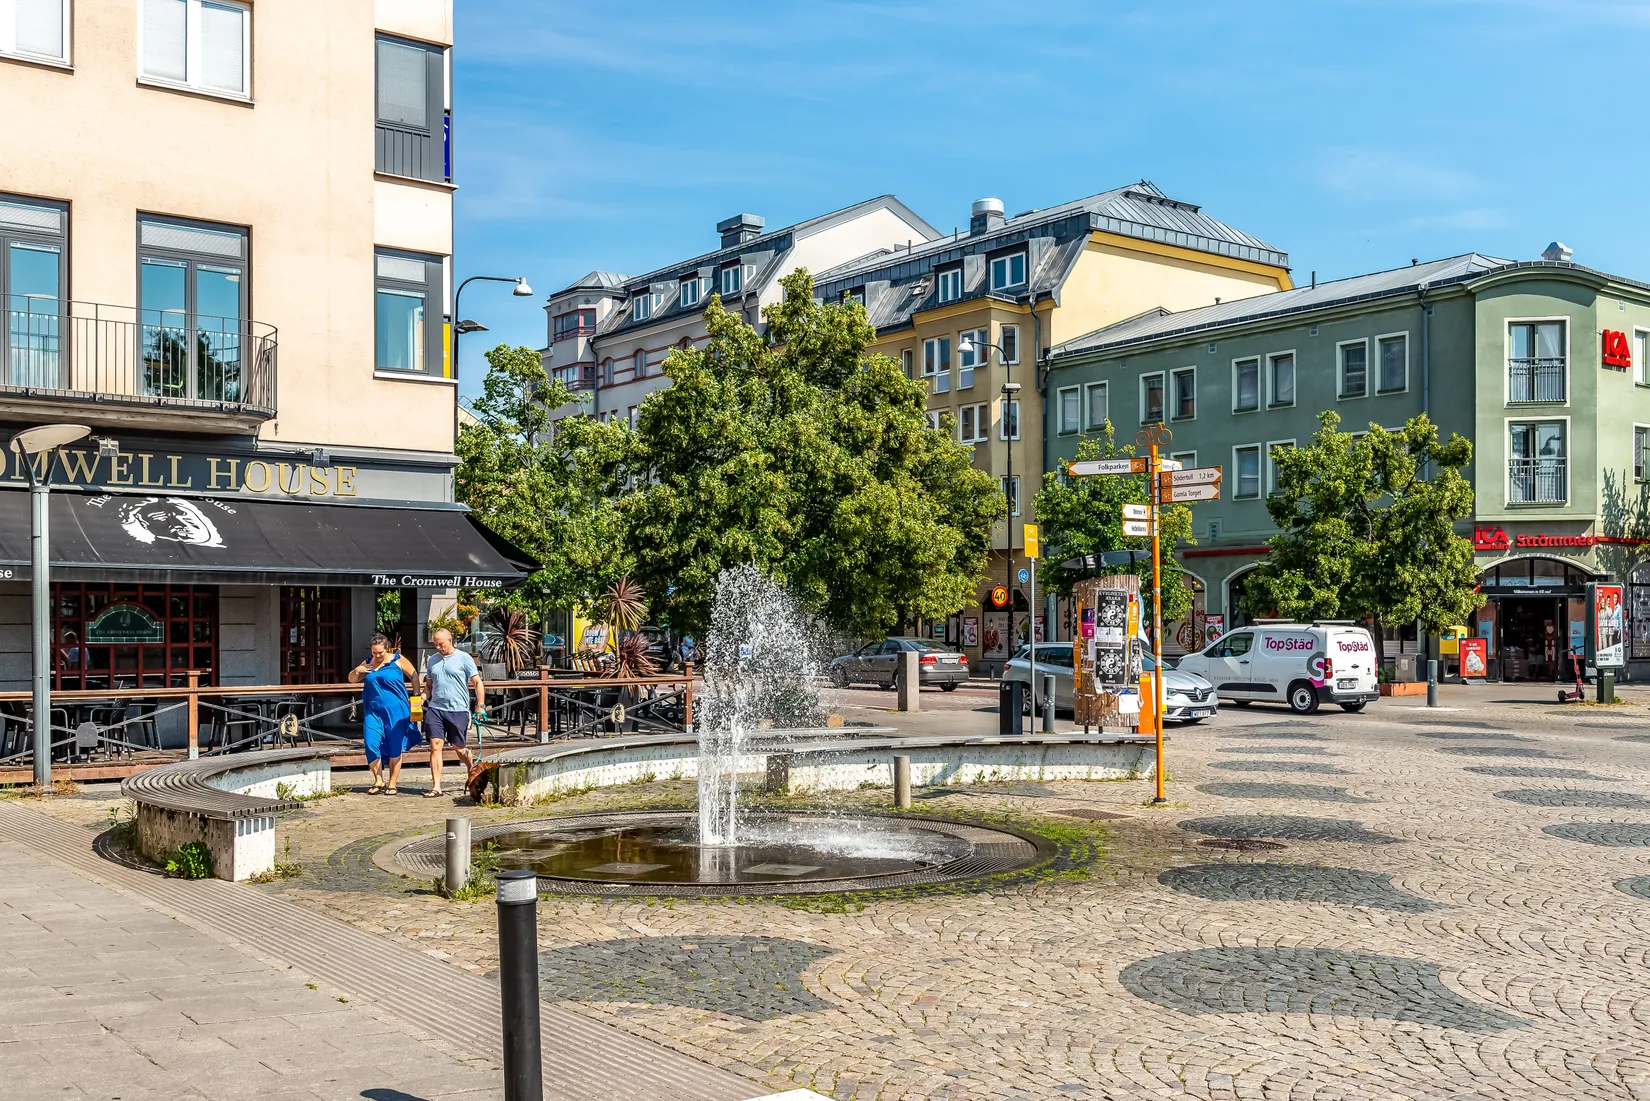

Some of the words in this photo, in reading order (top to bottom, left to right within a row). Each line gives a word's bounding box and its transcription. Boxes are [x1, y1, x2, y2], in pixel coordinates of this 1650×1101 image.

[1602, 329, 1631, 358] ICA
[0, 448, 192, 488] MWELL
[206, 458, 357, 496] HOUSE
[1098, 463, 1129, 472] Folkparken
[1173, 473, 1193, 482] Södertull
[1207, 471, 1215, 479] km
[1173, 490, 1187, 498] Gamla
[1187, 489, 1202, 498] Torget
[86, 493, 112, 510] The
[199, 497, 237, 515] ouse
[1475, 526, 1509, 543] ICA
[1516, 533, 1597, 547] Strömmen
[371, 574, 397, 586] The
[401, 575, 461, 587] Cromwell
[464, 576, 503, 588] House
[994, 591, 1005, 601] 40
[1265, 637, 1314, 651] TopStäd
[1336, 641, 1369, 652] TopStäd
